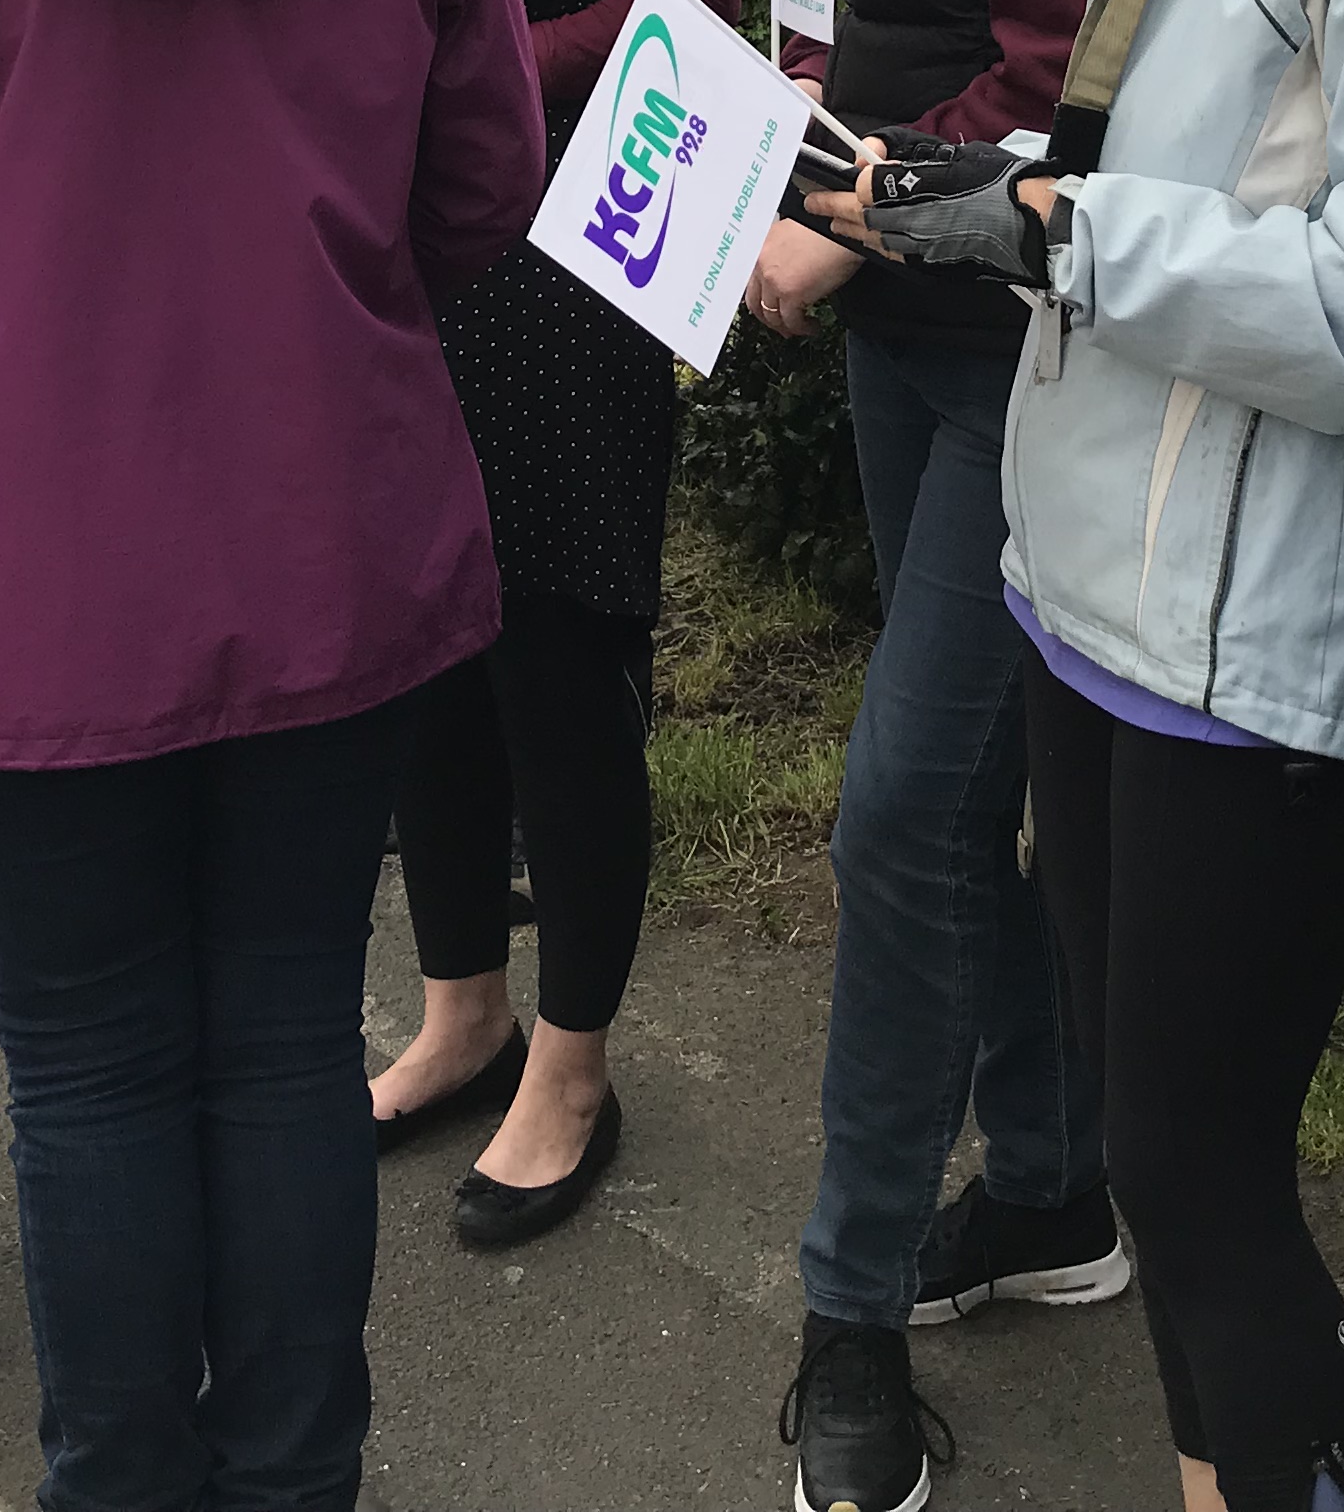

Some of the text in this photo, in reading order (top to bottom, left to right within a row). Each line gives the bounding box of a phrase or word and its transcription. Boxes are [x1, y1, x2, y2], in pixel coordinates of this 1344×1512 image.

[583, 88, 688, 266] KCFM
[675, 114, 708, 168] 99.8
[688, 300, 706, 328] FM
[704, 230, 735, 292] ONLINE
[731, 160, 763, 223] MOBILE
[759, 118, 778, 154] DAB
